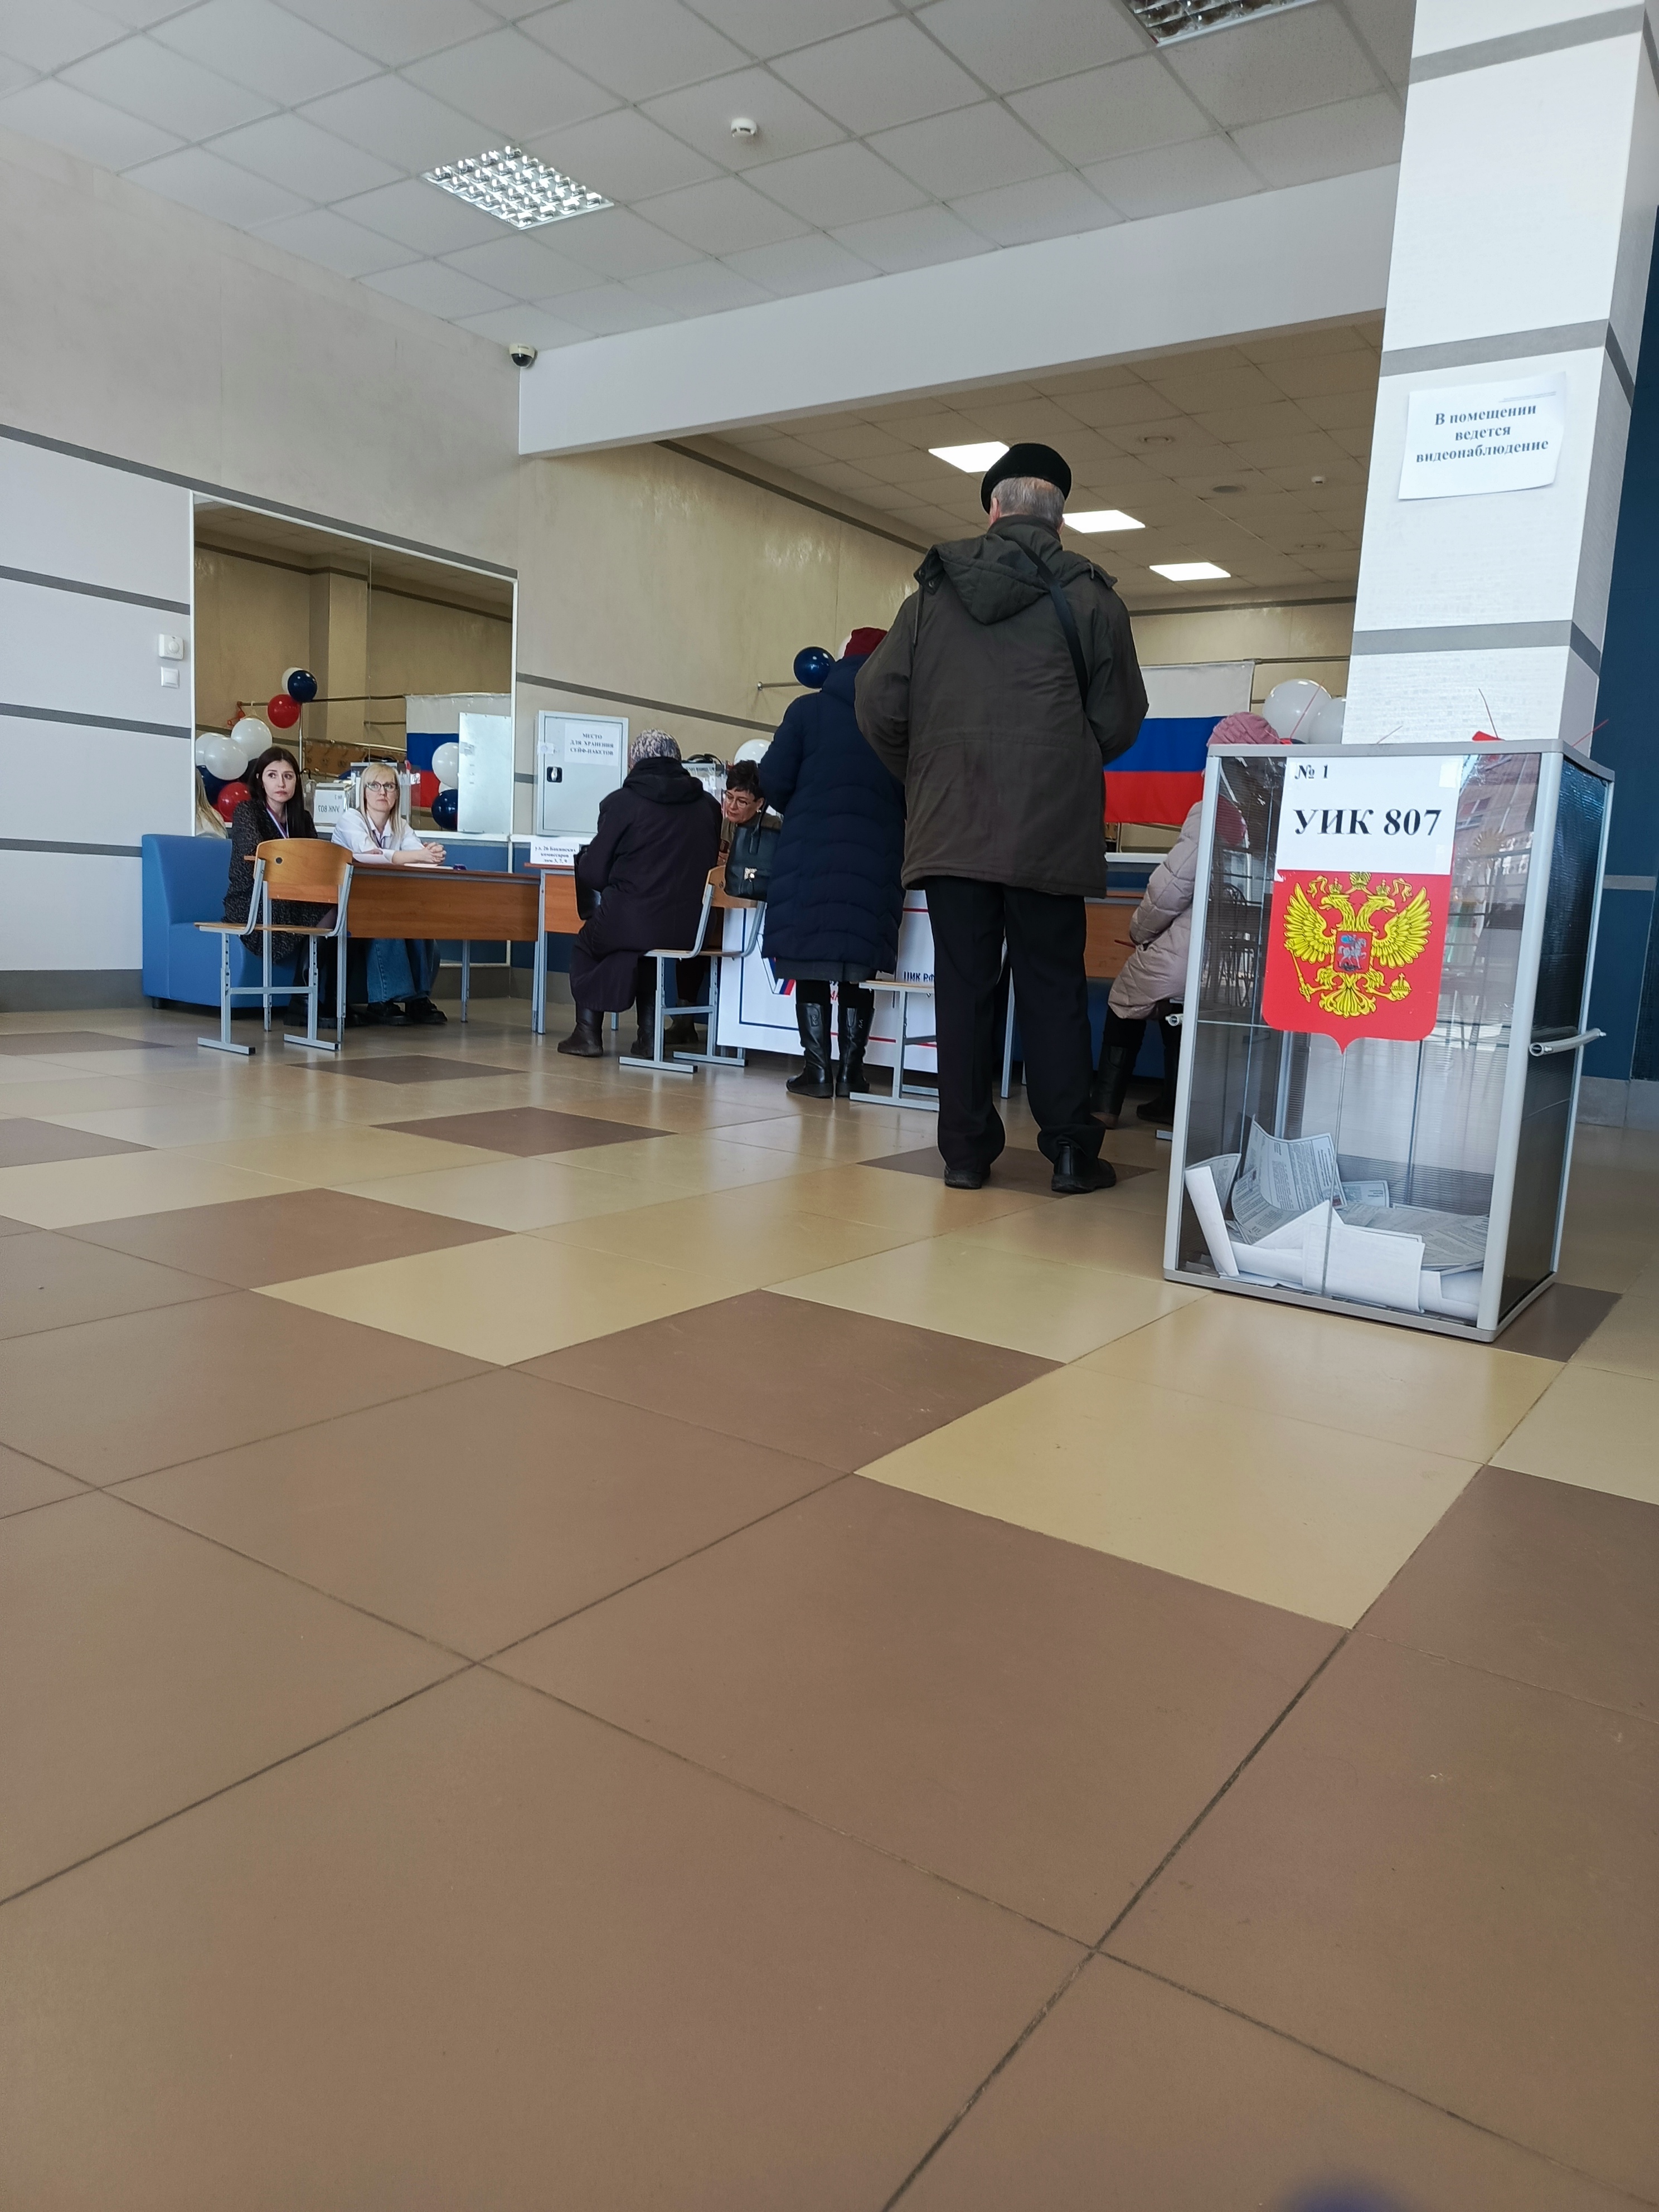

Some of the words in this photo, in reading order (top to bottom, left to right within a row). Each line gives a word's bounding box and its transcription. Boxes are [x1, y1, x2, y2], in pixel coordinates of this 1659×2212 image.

[1435, 413, 1445, 425] В
[1449, 405, 1536, 424] помещении
[1455, 426, 1511, 441] ведется
[1416, 440, 1549, 463] видеонаблюдение
[570, 747, 613, 755] СЕЙФ-ПАКЕТОВ
[1294, 764, 1315, 779] №
[1323, 764, 1328, 779] 1
[1292, 809, 1374, 835] УИК
[1383, 808, 1442, 836] 807
[904, 971, 921, 982] ЦИК
